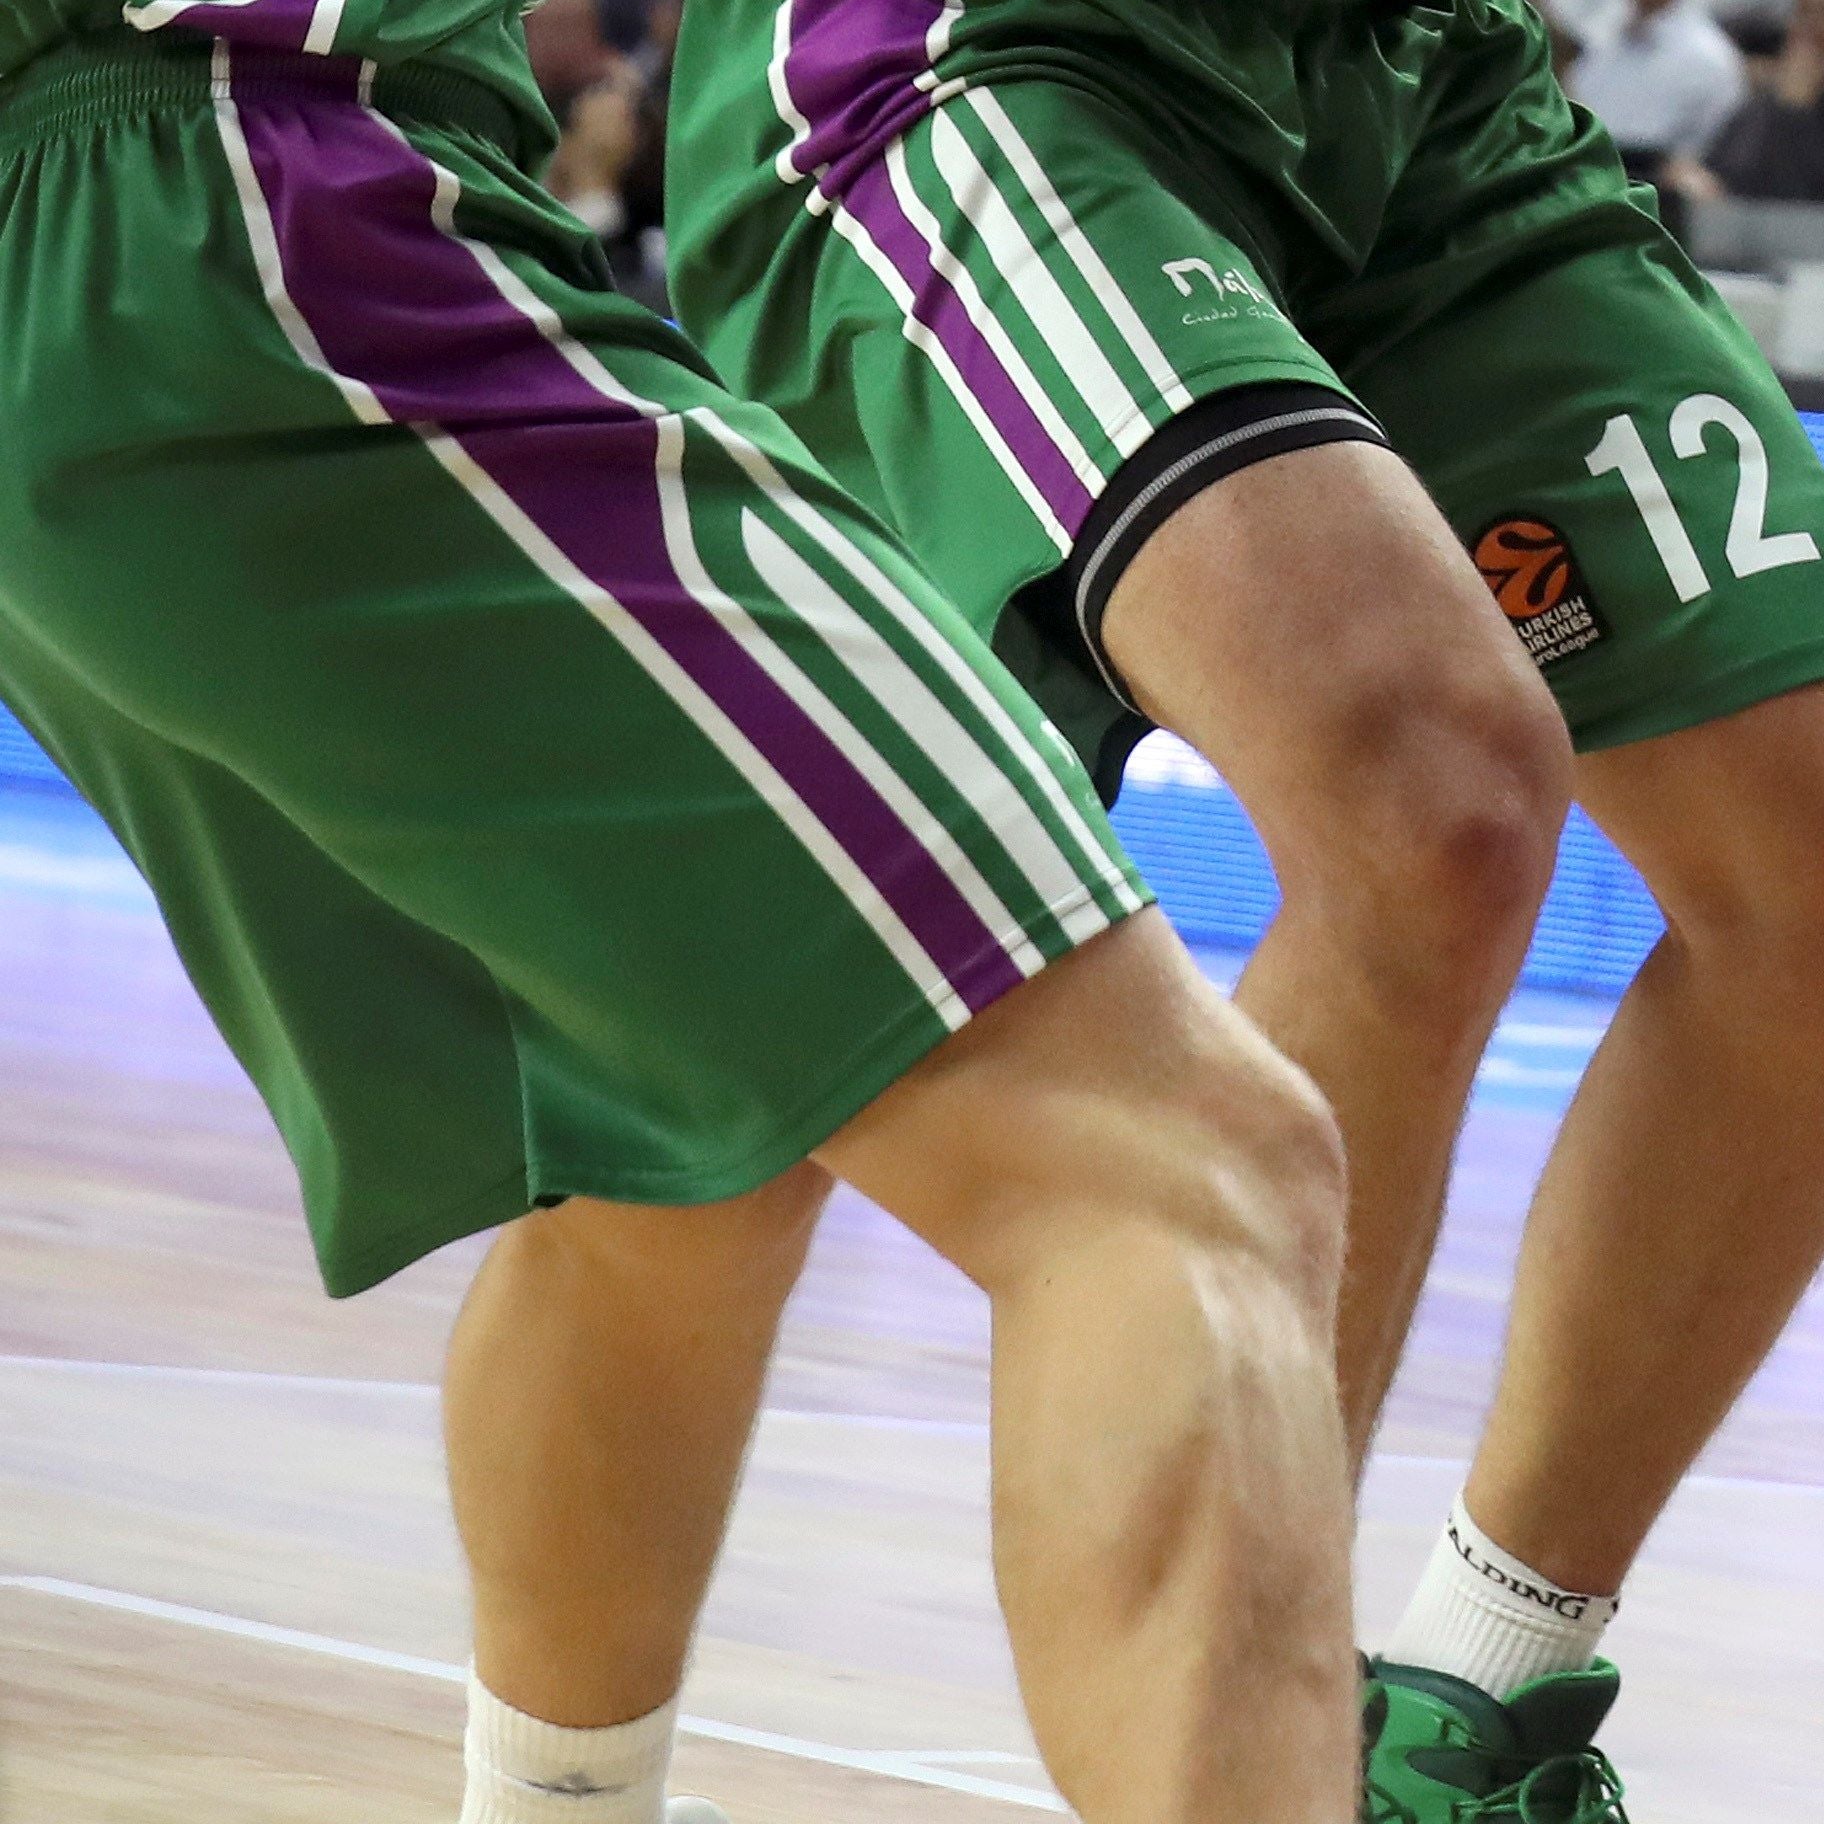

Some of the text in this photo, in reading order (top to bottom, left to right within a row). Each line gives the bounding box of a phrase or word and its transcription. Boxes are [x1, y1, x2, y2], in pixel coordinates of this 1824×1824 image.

[1584, 393, 1822, 604] 12
[1518, 595, 1587, 639] URKISH
[1527, 611, 1594, 653] IRLINES
